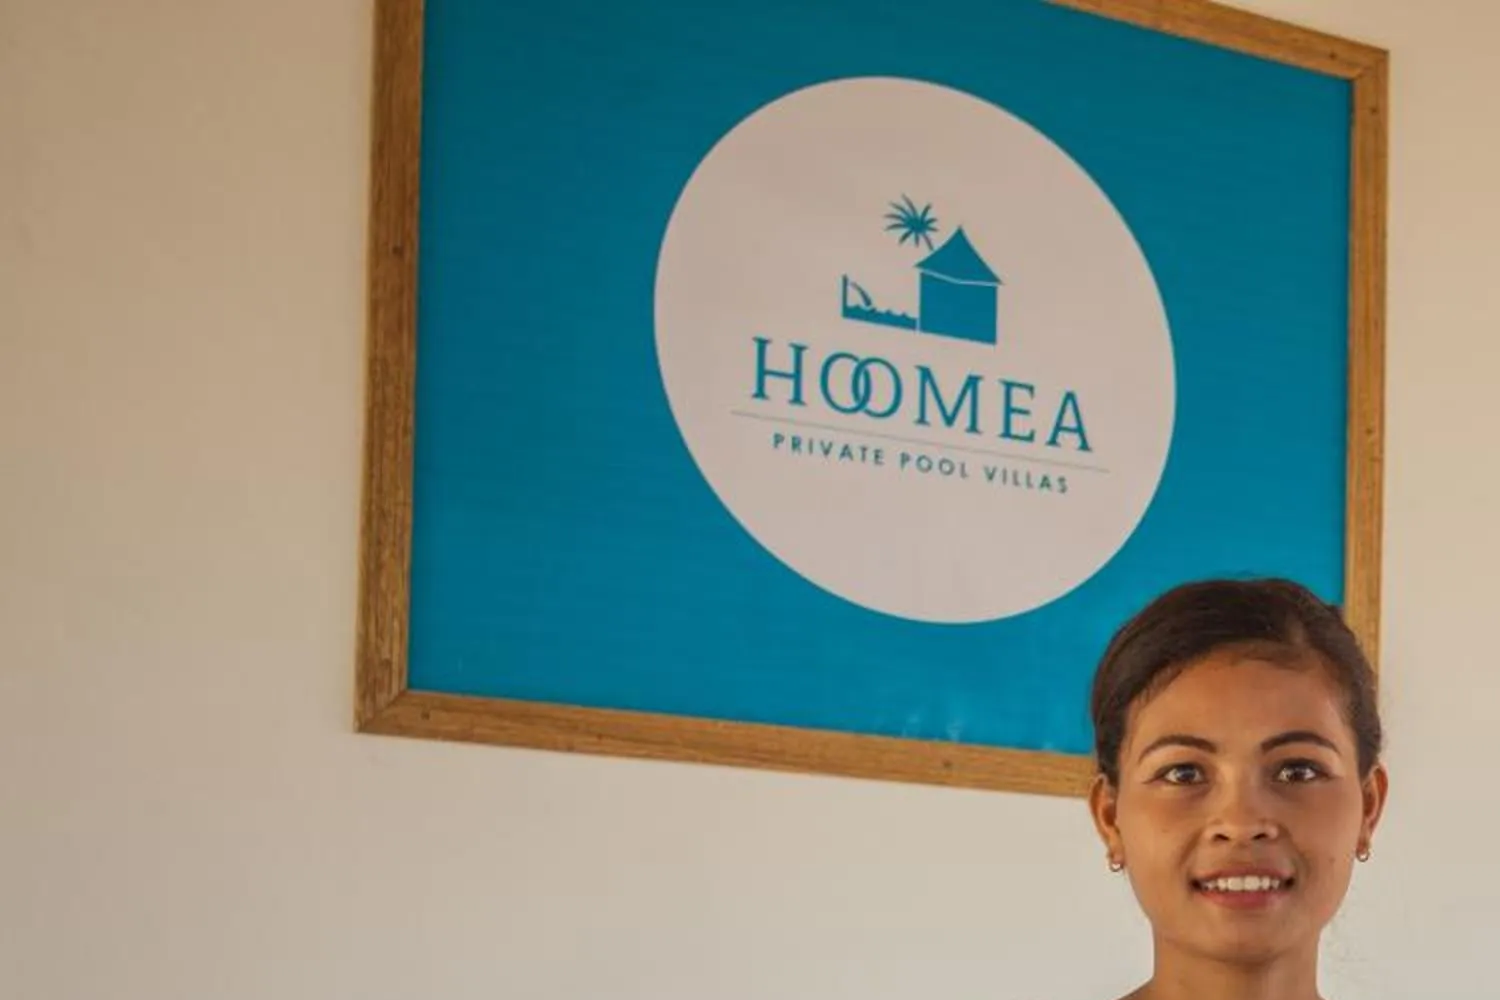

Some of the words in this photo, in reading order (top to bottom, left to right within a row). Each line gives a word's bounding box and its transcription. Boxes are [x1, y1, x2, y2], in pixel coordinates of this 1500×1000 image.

[751, 336, 1093, 453] HOOMEA
[772, 433, 885, 465] PRIVATE
[900, 452, 968, 478] POOL
[984, 465, 1068, 494] VILLAS
